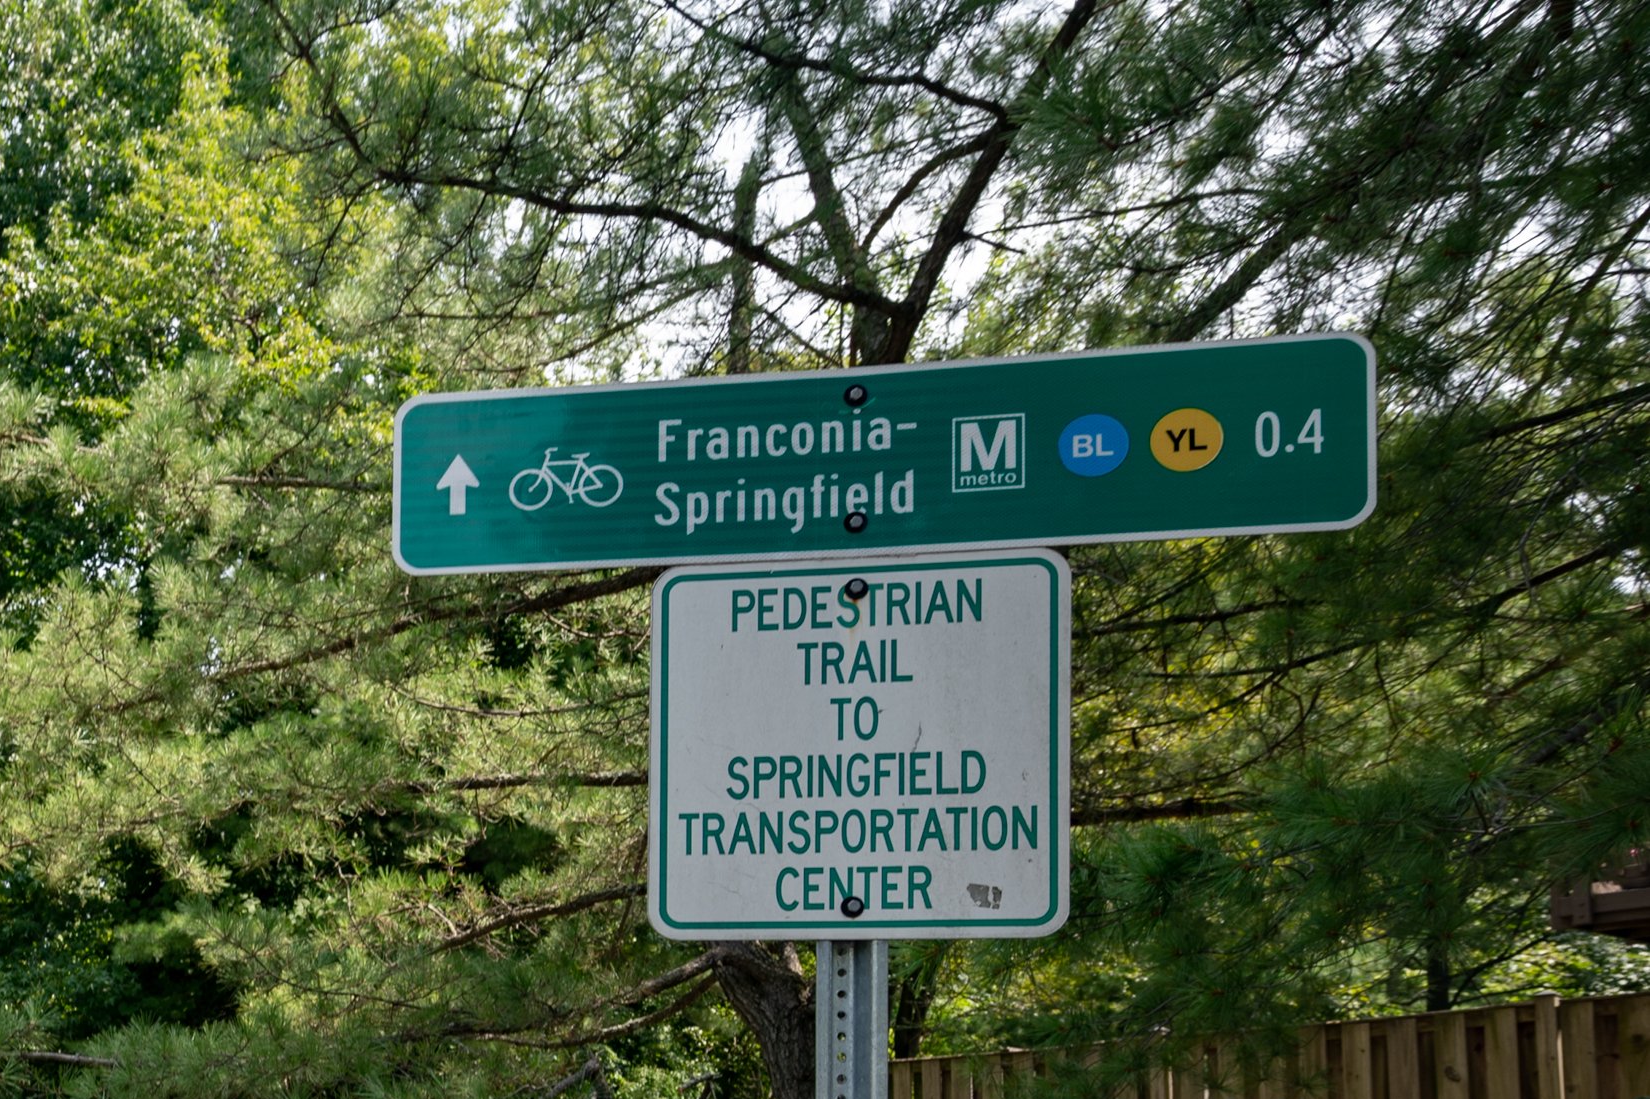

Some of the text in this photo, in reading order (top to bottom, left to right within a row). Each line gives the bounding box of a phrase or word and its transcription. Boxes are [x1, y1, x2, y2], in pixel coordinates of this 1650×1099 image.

[657, 408, 918, 462] Franconia-
[959, 419, 1018, 472] M
[1071, 433, 1115, 458] BL
[1165, 427, 1209, 453] YL
[1254, 407, 1325, 458] 0.4
[654, 469, 915, 535] Springfield
[959, 470, 1018, 488] metro
[731, 578, 983, 632] PEDESTRIAN
[796, 639, 914, 686] TRAIL
[830, 696, 879, 741] TO
[726, 750, 987, 800] SPRINGFIELD
[678, 805, 1039, 856] TRANSPORTATION
[775, 866, 933, 912] CENTER
